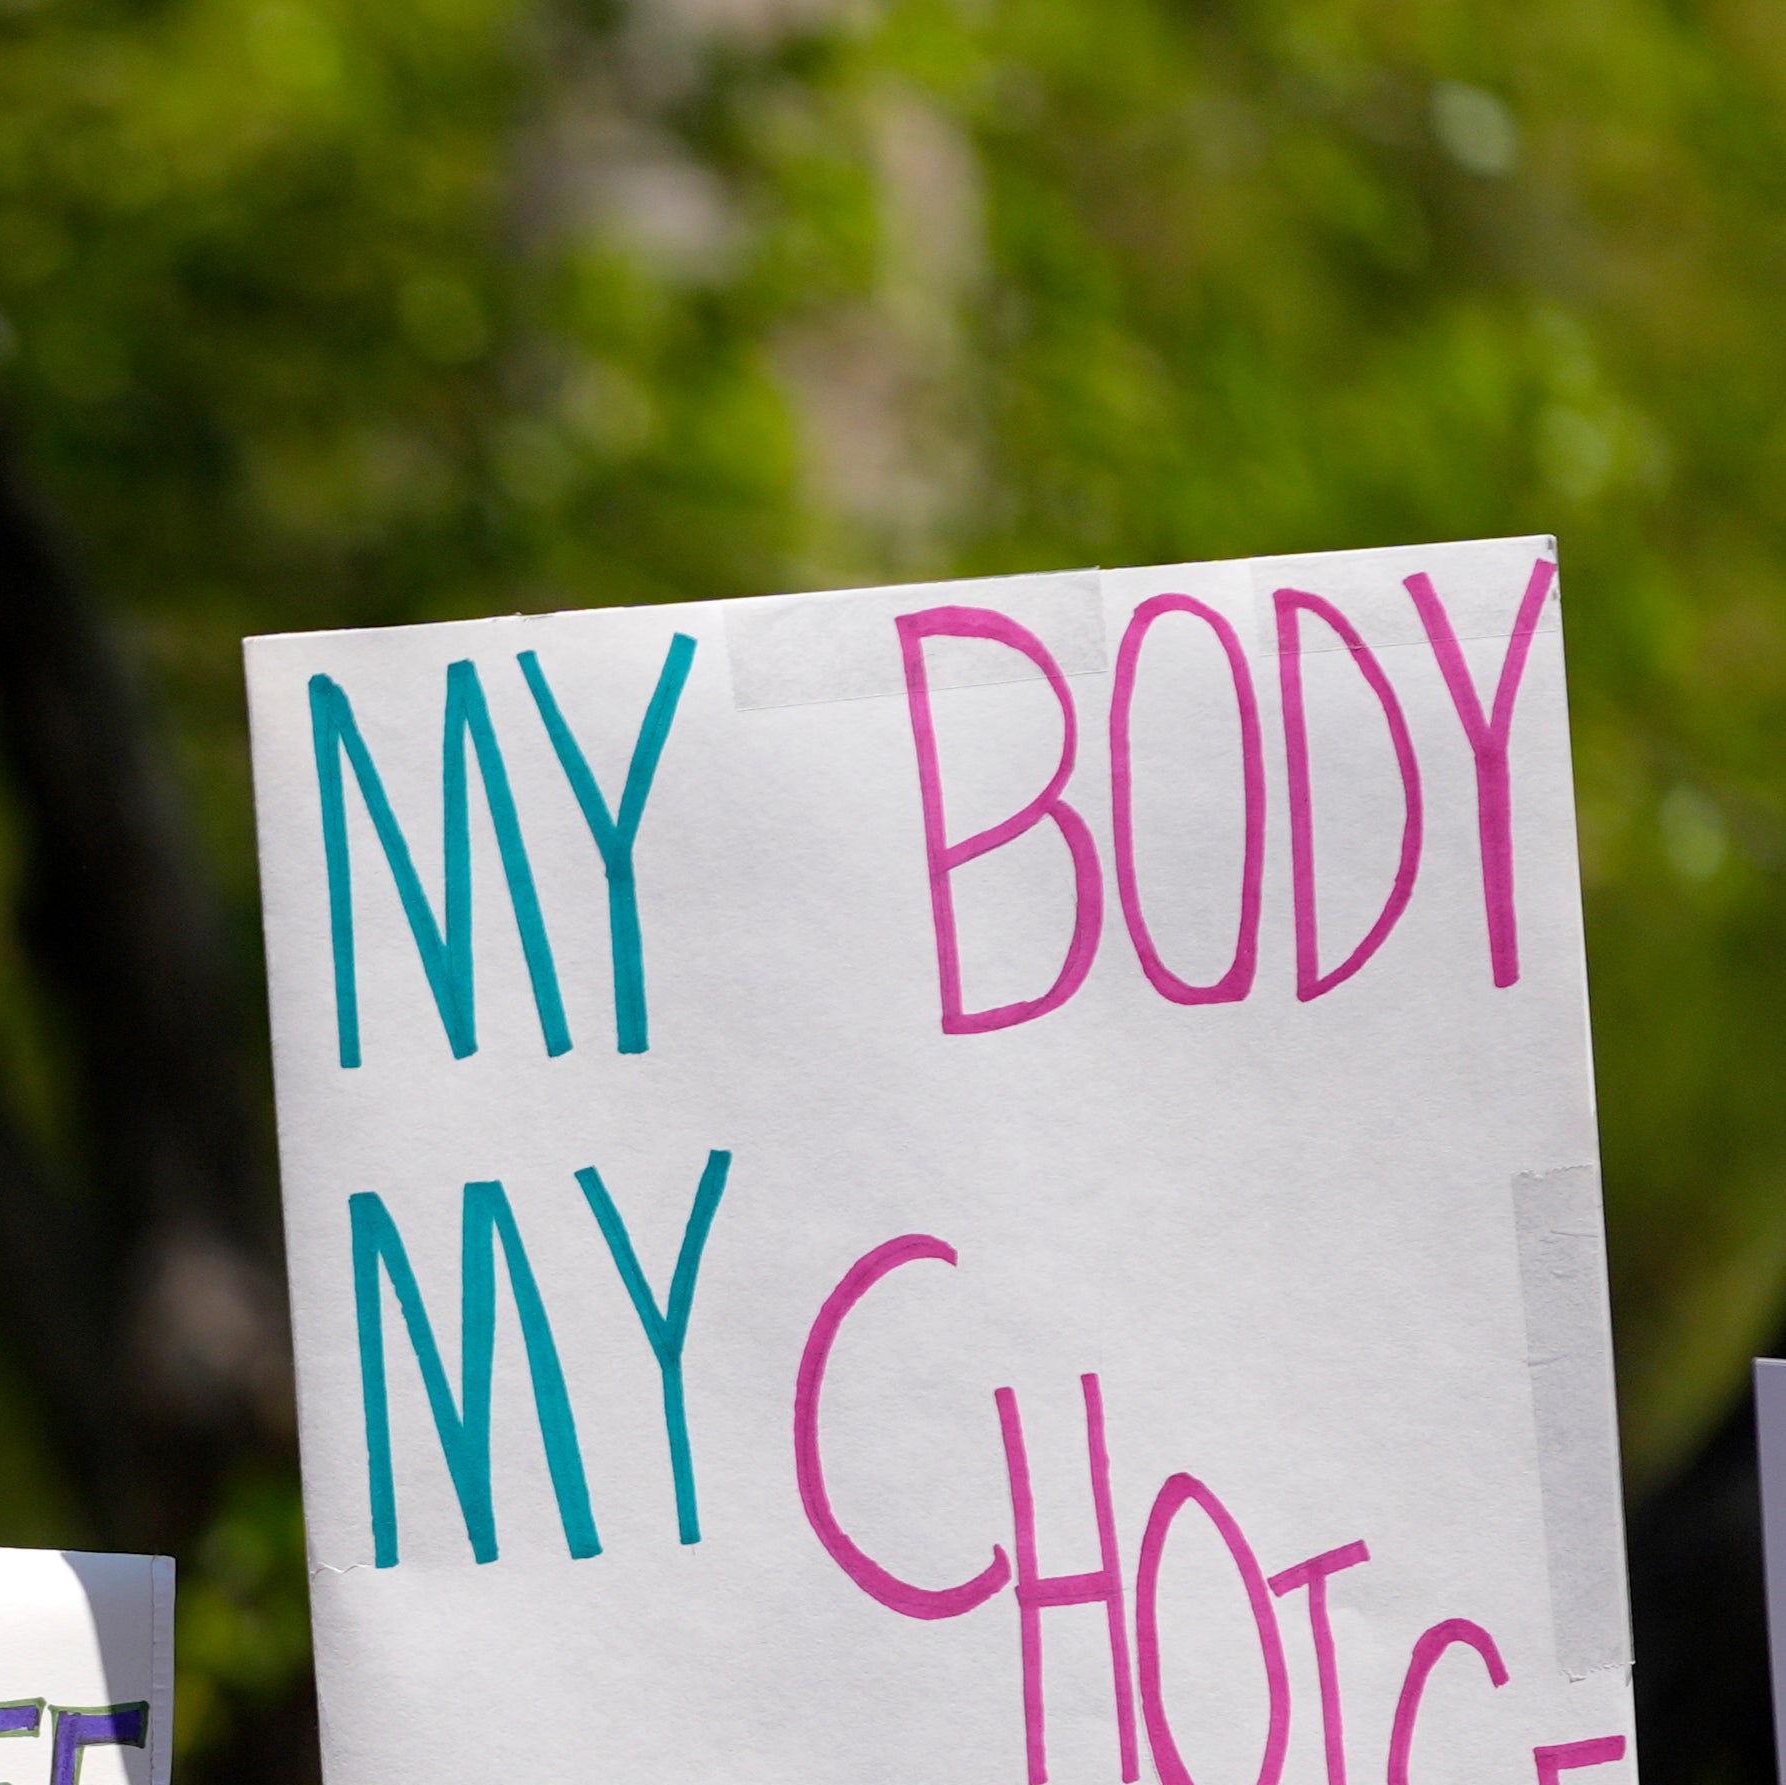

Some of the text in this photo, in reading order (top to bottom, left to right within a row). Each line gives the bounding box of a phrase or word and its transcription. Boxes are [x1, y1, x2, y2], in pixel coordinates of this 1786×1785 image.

[308, 558, 1557, 1069] MY BODY
[348, 1148, 732, 1569] MY
